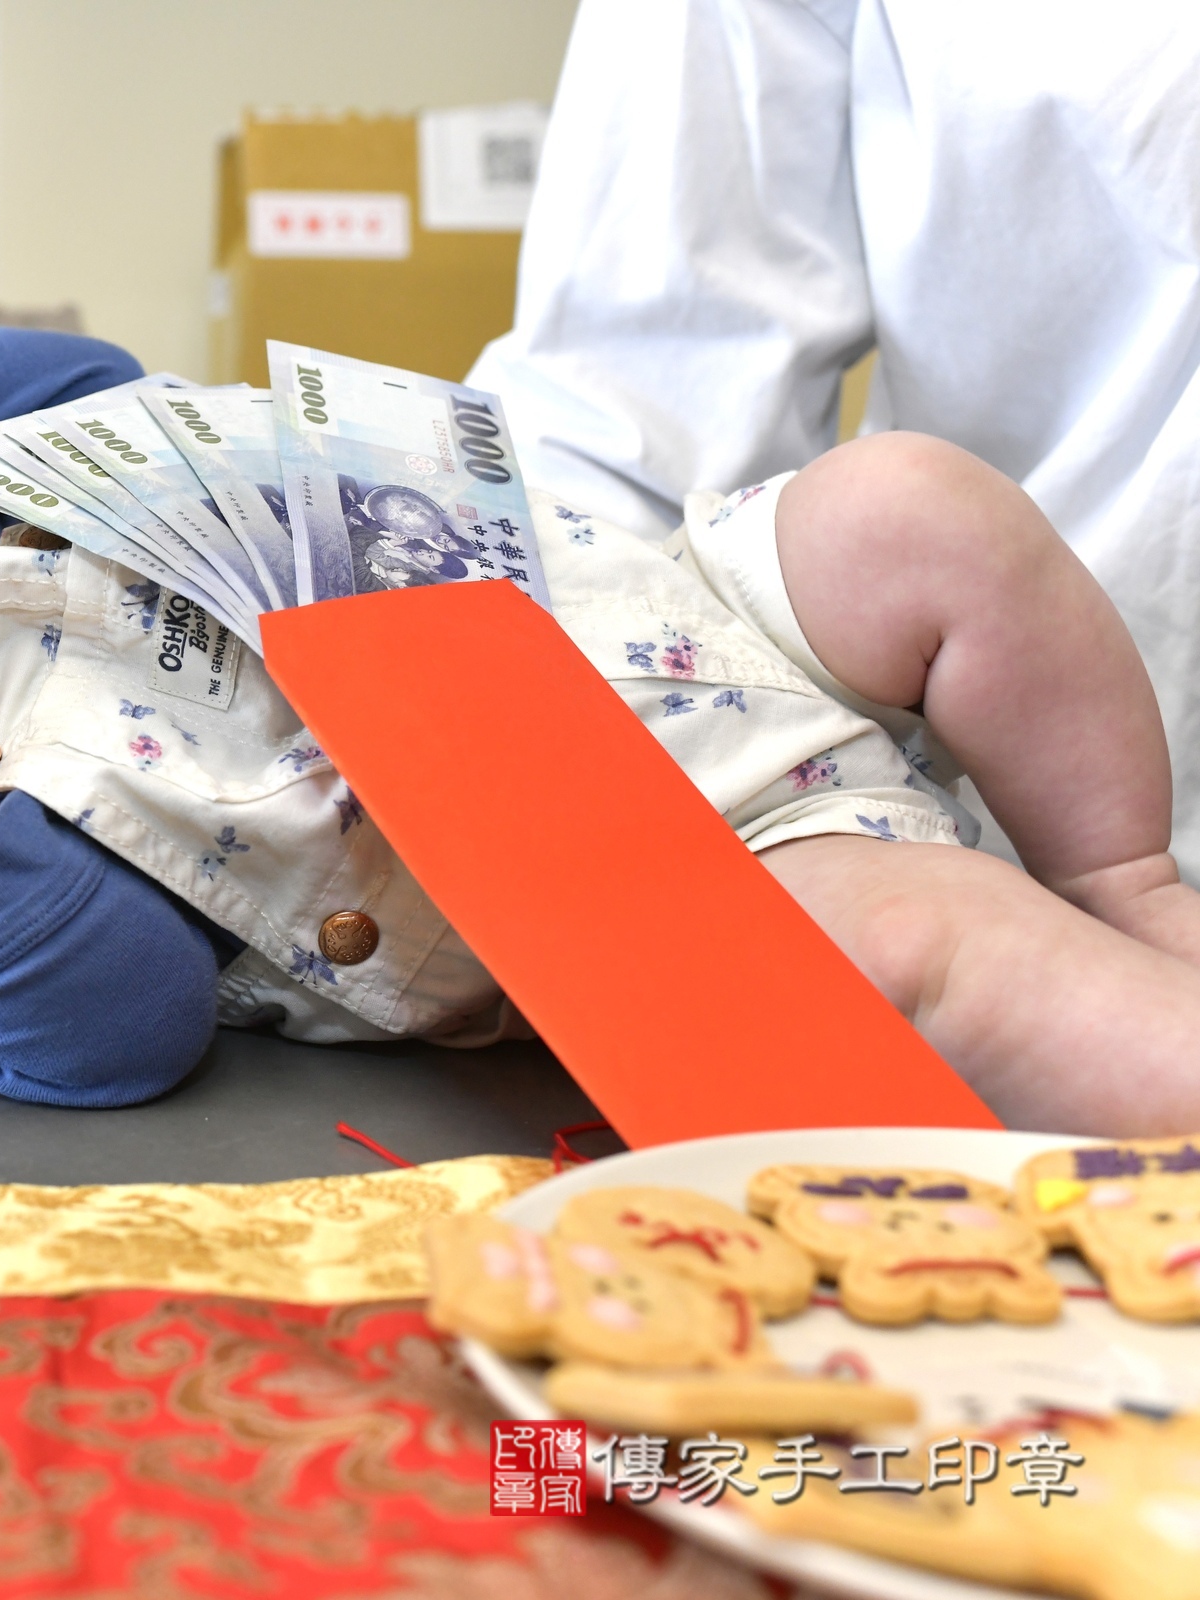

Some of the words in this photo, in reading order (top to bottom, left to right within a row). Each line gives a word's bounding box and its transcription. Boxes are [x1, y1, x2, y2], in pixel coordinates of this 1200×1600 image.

[296, 363, 329, 425] 1000
[75, 418, 148, 464] 1000
[165, 399, 222, 444] 1000
[450, 393, 513, 486] 1000
[36, 431, 112, 478] 1000
[488, 518, 531, 598] 中華民
[211, 625, 230, 674] GENUINE
[208, 679, 221, 696] THE
